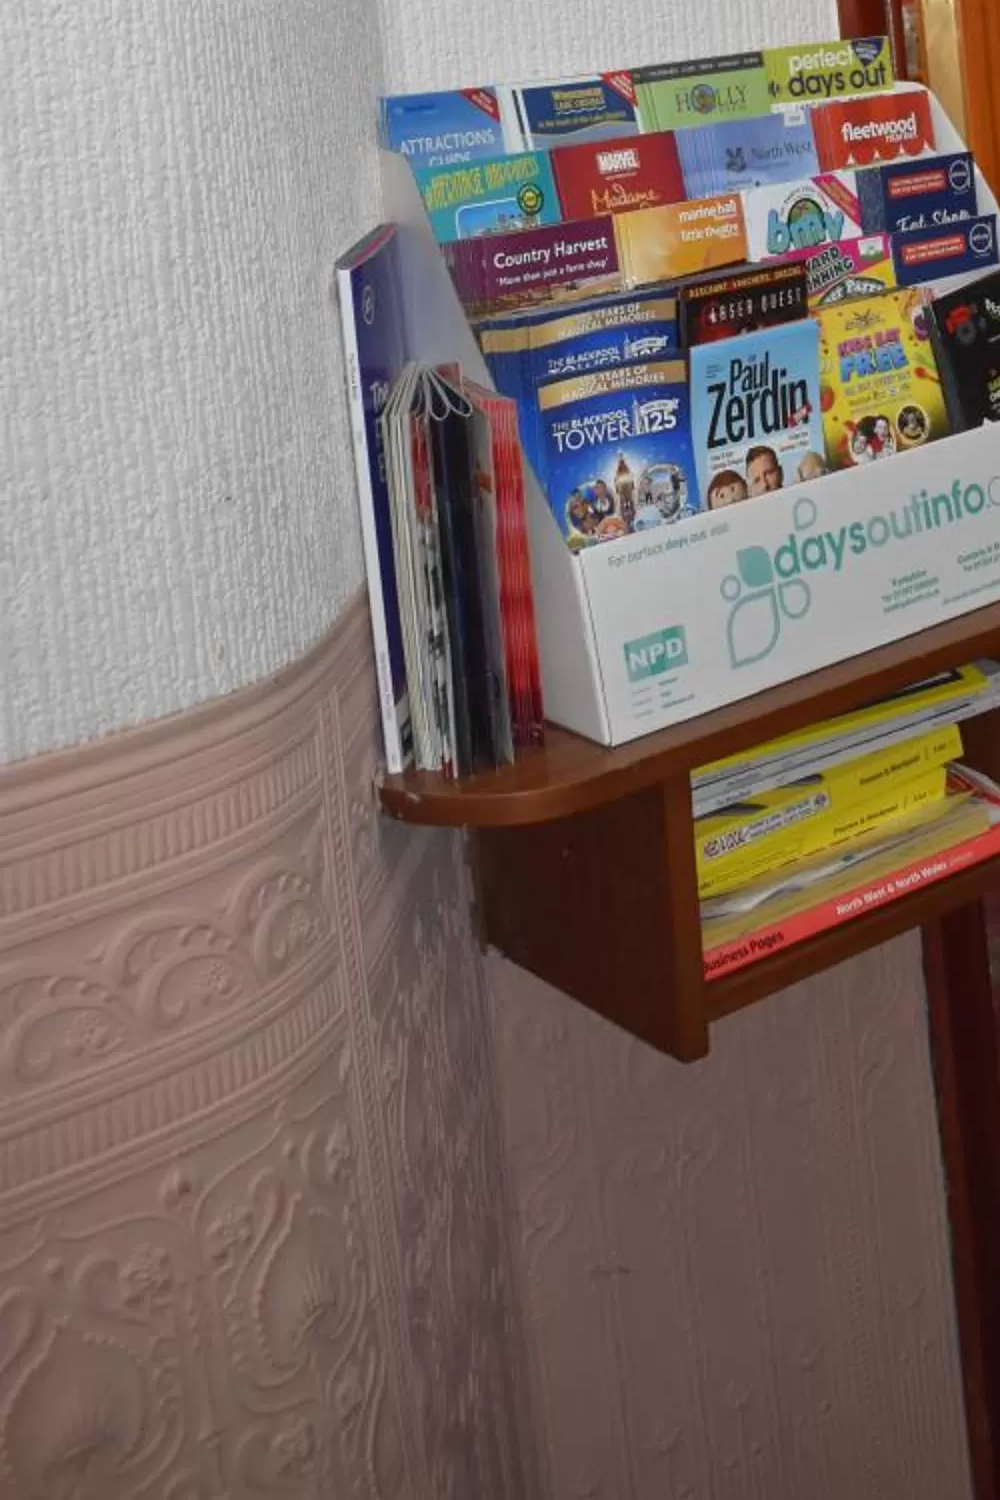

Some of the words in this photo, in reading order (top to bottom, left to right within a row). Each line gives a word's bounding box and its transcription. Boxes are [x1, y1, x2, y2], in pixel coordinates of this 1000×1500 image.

[788, 69, 844, 98] days
[850, 61, 886, 89] out
[400, 128, 496, 155] ATTRACTIONS
[841, 112, 917, 142] fleetwood
[597, 148, 640, 173] MARVEL
[493, 248, 550, 269] Country
[554, 237, 608, 257] Harvest
[806, 246, 840, 272] ARD
[605, 310, 656, 326] MEMORIES
[566, 347, 620, 366] BLACKPOOL
[839, 343, 909, 382] FREE
[612, 372, 665, 389] MEMORIES
[730, 351, 769, 395] Paul
[552, 422, 570, 433] THE
[571, 409, 628, 427] BLACKPOOL
[707, 368, 809, 448] Zerdin
[552, 418, 632, 452] TOWER
[629, 636, 683, 674] NPD
[750, 930, 784, 954] Pages
[895, 871, 921, 889] North
